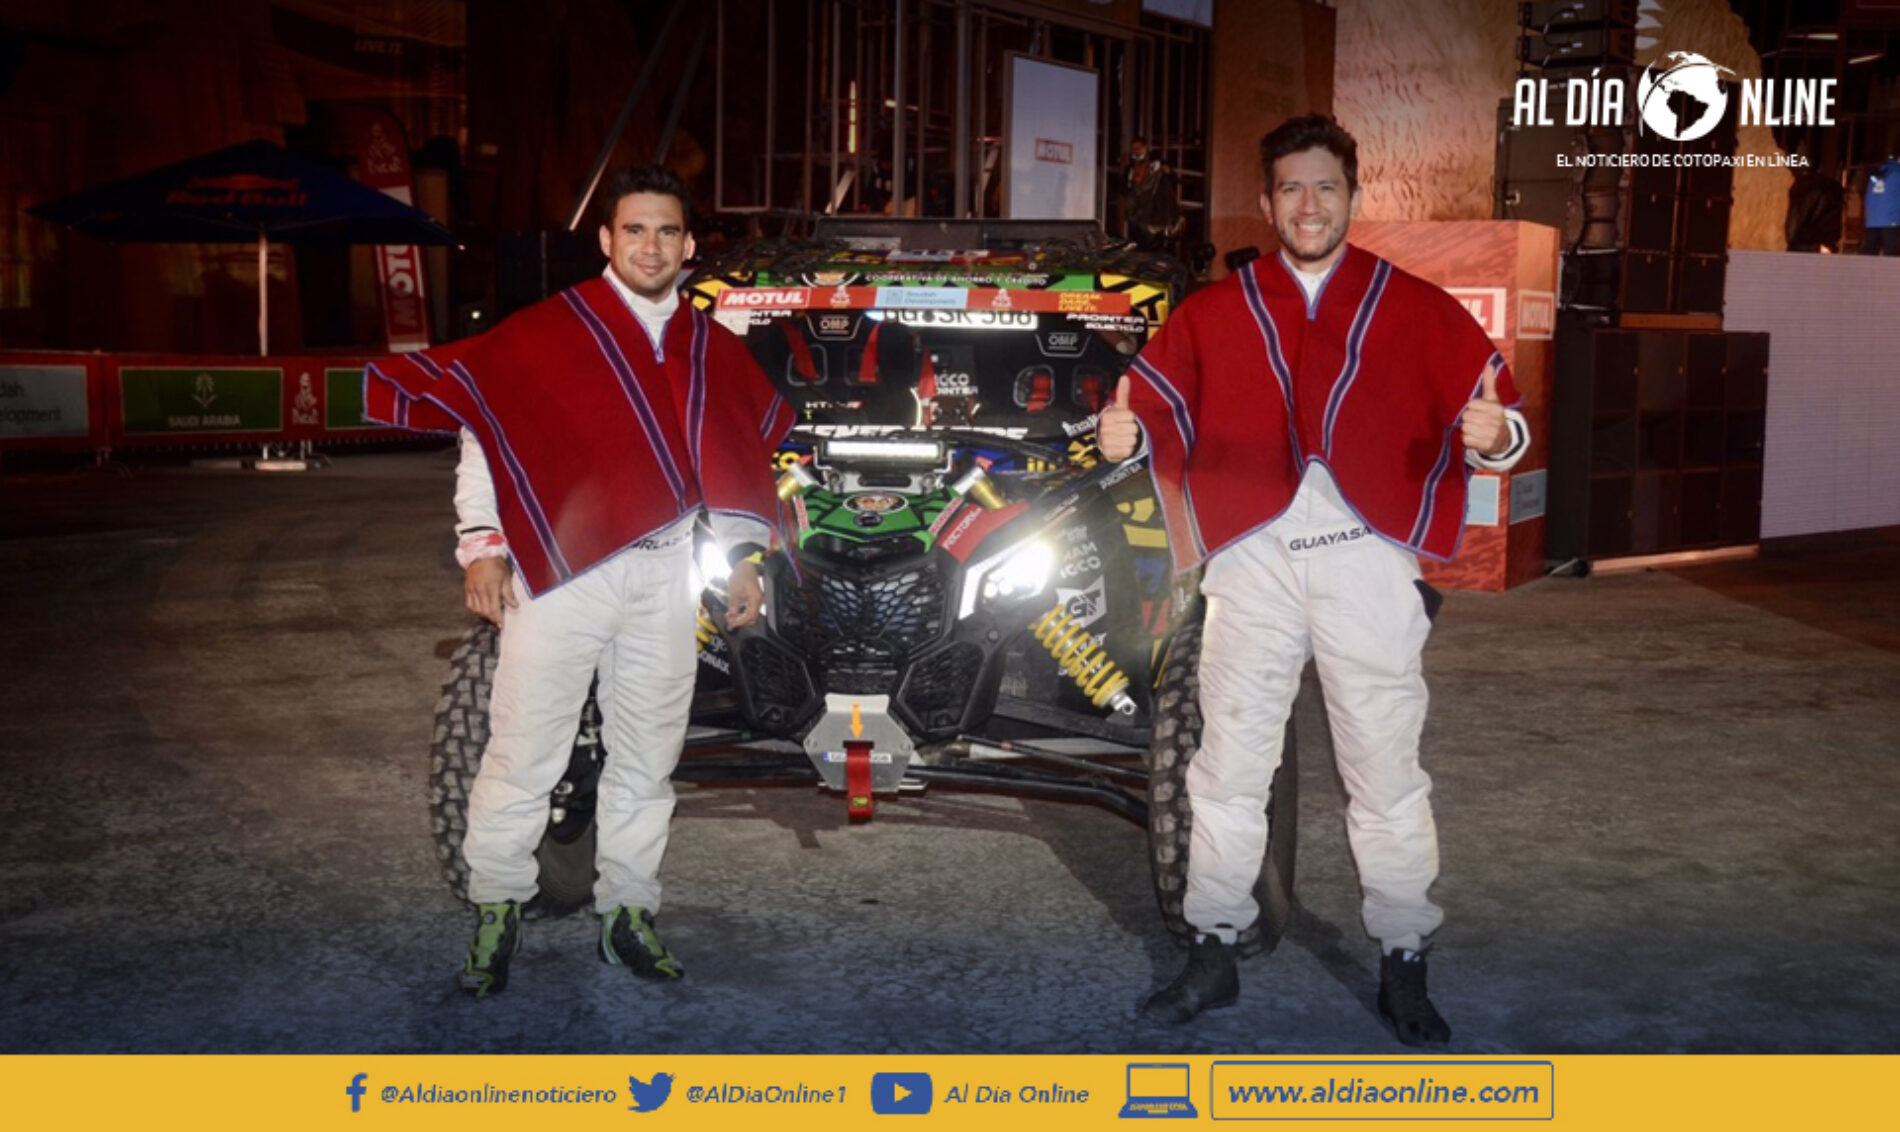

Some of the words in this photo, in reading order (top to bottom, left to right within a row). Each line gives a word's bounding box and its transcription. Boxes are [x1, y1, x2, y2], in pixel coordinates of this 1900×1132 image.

[240, 190, 308, 206] Bull
[724, 289, 804, 305] MOTUL
[819, 319, 850, 331] OMP
[1048, 334, 1078, 345] OMP
[167, 415, 199, 429] SAUDI
[201, 414, 242, 427] ARABIA
